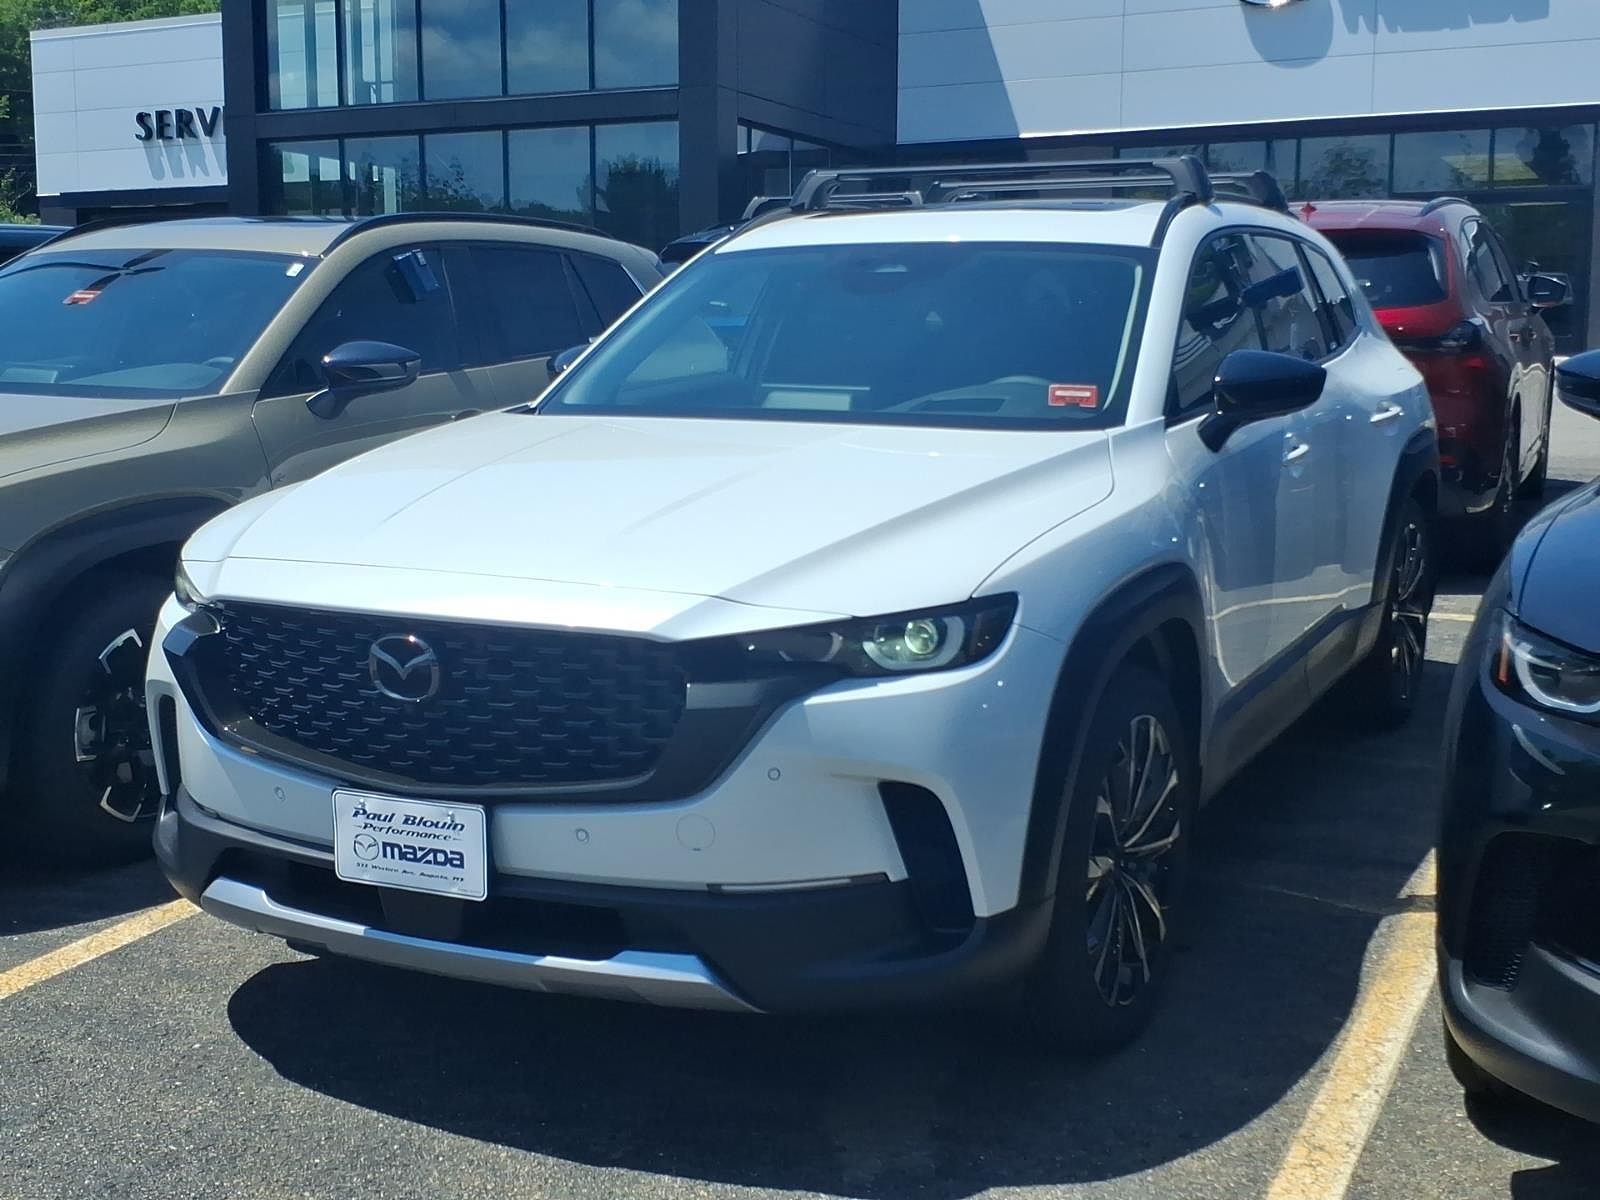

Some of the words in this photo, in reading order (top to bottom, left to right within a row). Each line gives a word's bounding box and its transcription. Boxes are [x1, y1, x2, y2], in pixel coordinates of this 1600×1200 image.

[135, 106, 224, 141] SERV
[352, 807, 396, 823] Paul
[402, 814, 466, 832] Blouin
[361, 822, 452, 841] Performance
